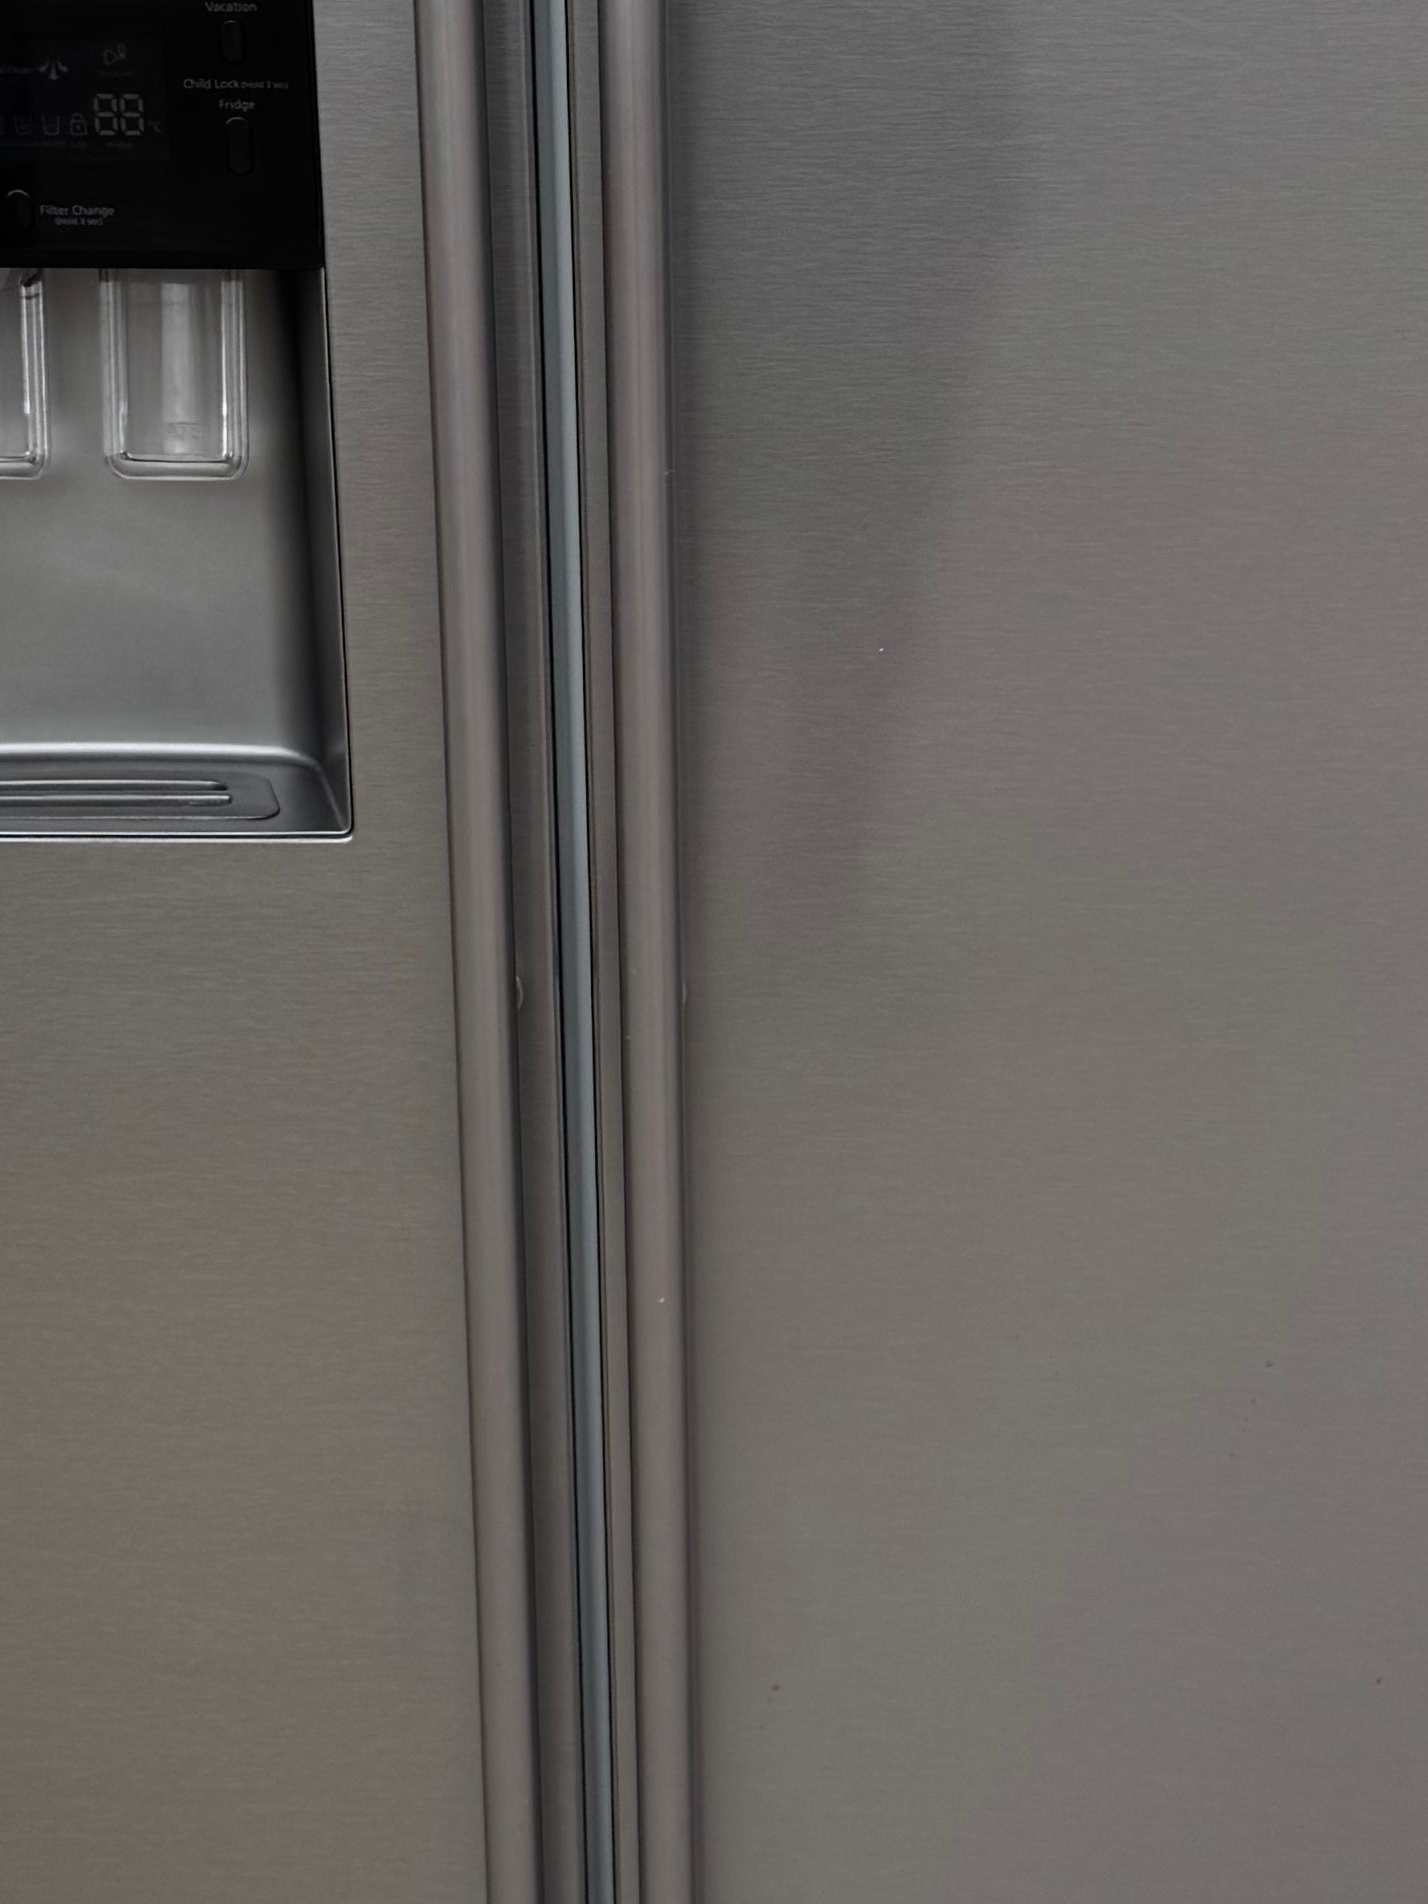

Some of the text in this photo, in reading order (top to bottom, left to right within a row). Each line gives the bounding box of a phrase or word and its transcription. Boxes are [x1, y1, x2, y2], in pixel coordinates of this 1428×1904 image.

[204, 0, 259, 13] Vacation
[218, 99, 257, 114] Fridge
[39, 204, 116, 218] Filter Change
